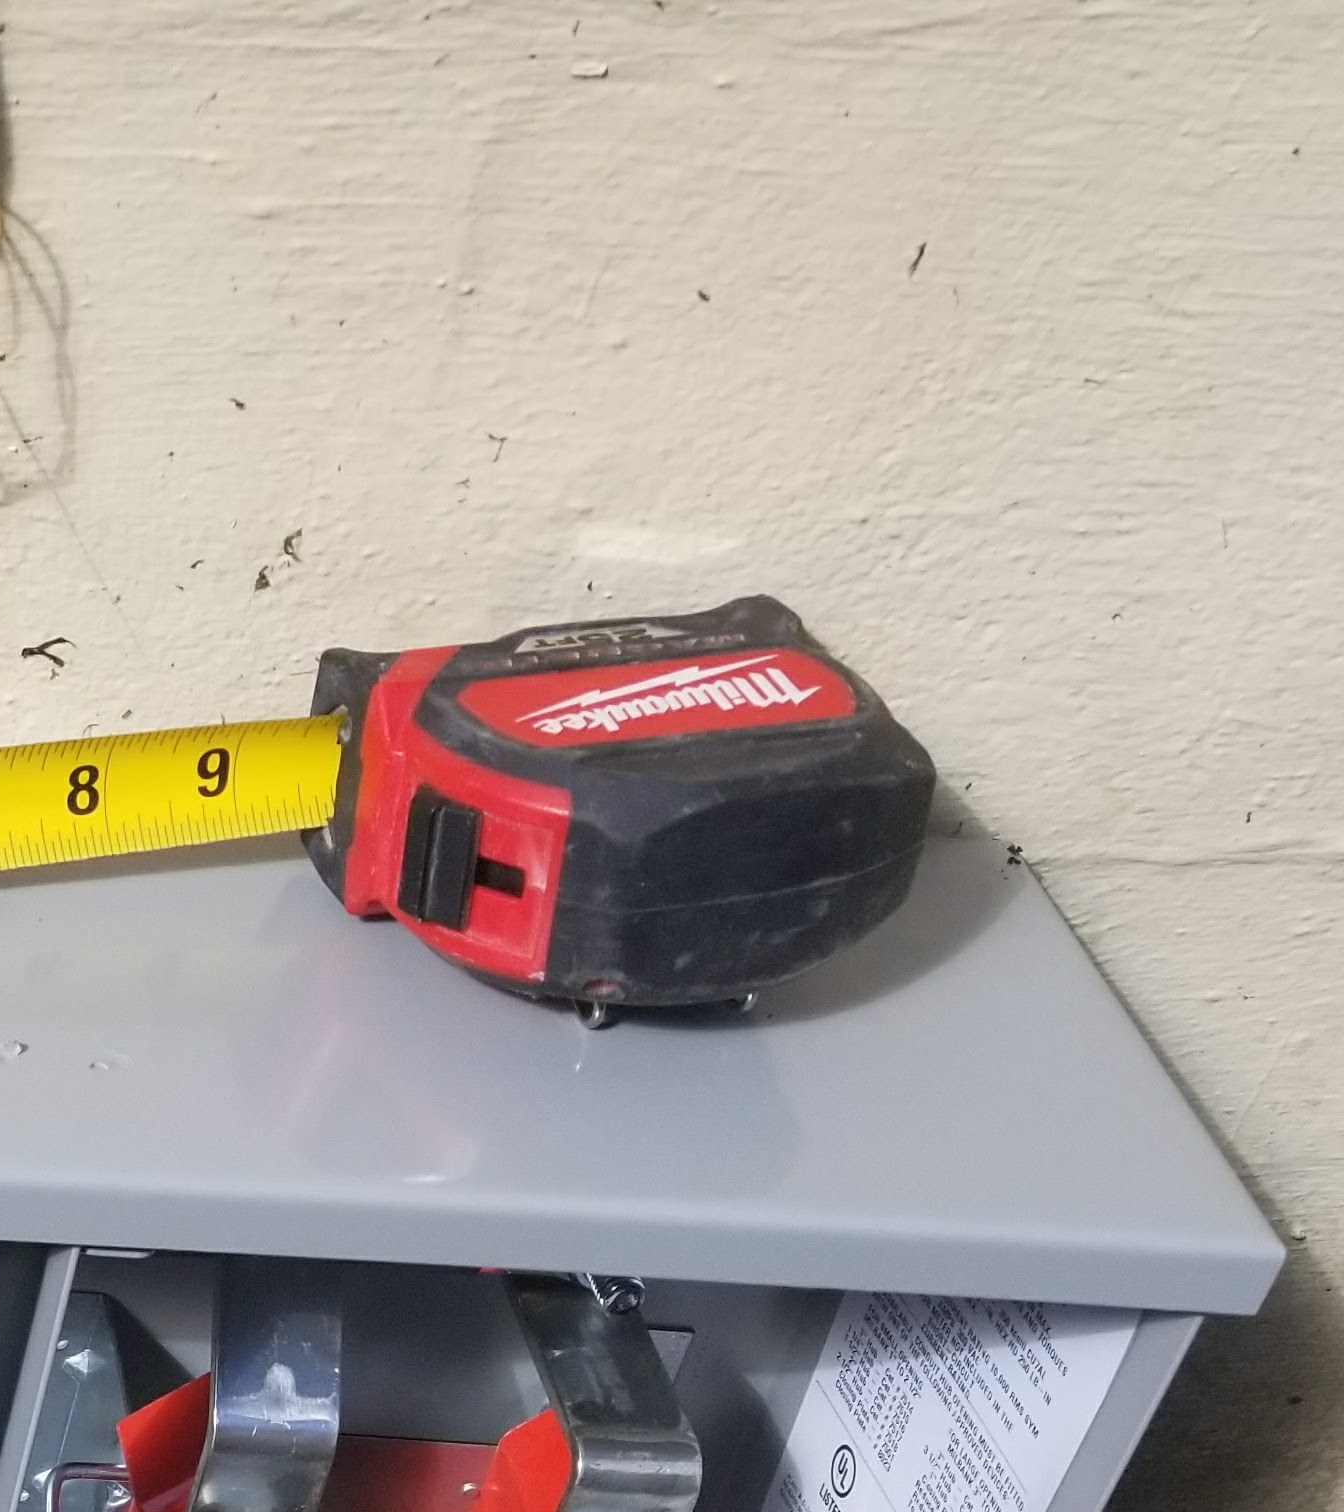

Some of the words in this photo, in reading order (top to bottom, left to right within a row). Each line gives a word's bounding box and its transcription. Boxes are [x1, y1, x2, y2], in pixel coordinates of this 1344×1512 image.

[533, 666, 825, 736] Milwaukee
[67, 764, 101, 816] 8
[196, 747, 230, 799] 9
[1008, 1390, 1025, 1417] RMS
[1022, 1412, 1039, 1440] SYM
[946, 1442, 974, 1488] MILBANK
[958, 1446, 979, 1480] LARGE
[977, 1433, 996, 1464] MUST
[994, 1461, 1004, 1479] BE
[1002, 1476, 1025, 1512] FITTED
[982, 1458, 1010, 1503] DEVICES:
